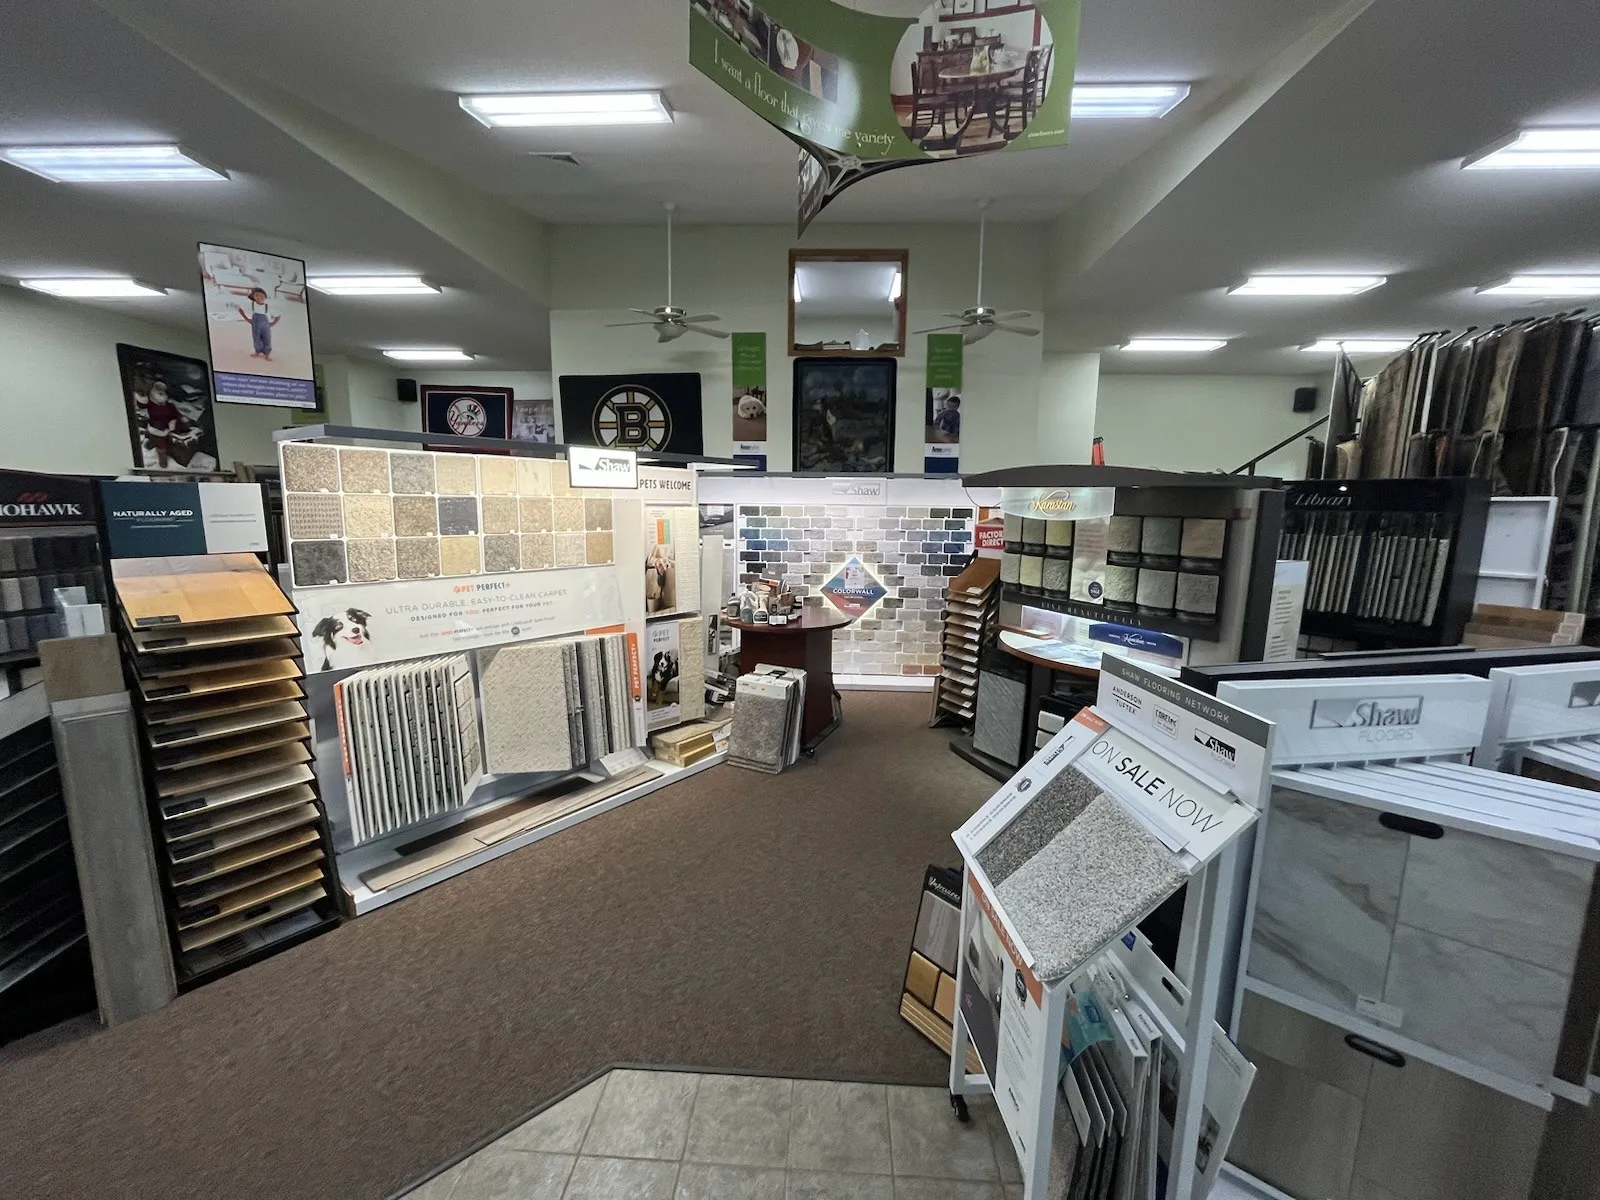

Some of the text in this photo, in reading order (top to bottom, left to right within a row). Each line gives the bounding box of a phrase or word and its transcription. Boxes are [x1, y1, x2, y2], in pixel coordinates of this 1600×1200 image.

[713, 38, 719, 64] I
[721, 57, 743, 84] want
[744, 79, 751, 90] a
[753, 71, 779, 107] floor
[781, 90, 800, 119] that
[797, 110, 832, 136] gives
[834, 125, 852, 140] me
[613, 403, 650, 447] B
[598, 457, 632, 473] Shaw
[639, 479, 692, 491] PETS WELCOME
[848, 483, 880, 496] Shaw
[1294, 492, 1353, 506] Library
[978, 530, 1005, 540] FACTOR
[981, 539, 1004, 547] DIRECT
[385, 604, 419, 615] ULTRA
[470, 592, 537, 606] EASY-TO-CLEAN
[410, 612, 448, 622] DESIGNED
[448, 610, 464, 618] FOR
[482, 605, 511, 614] PERFECT
[525, 601, 542, 609] YOUR
[1112, 686, 1143, 705] ANDERSON
[1121, 668, 1230, 724] SHAW FLOORING NETWORK
[1115, 699, 1136, 715] TUFTEX
[1354, 701, 1421, 727] Shaw
[1357, 728, 1415, 743] FLOORS
[1207, 736, 1236, 762] Shaw
[1092, 740, 1223, 833] ON SALE NOW
